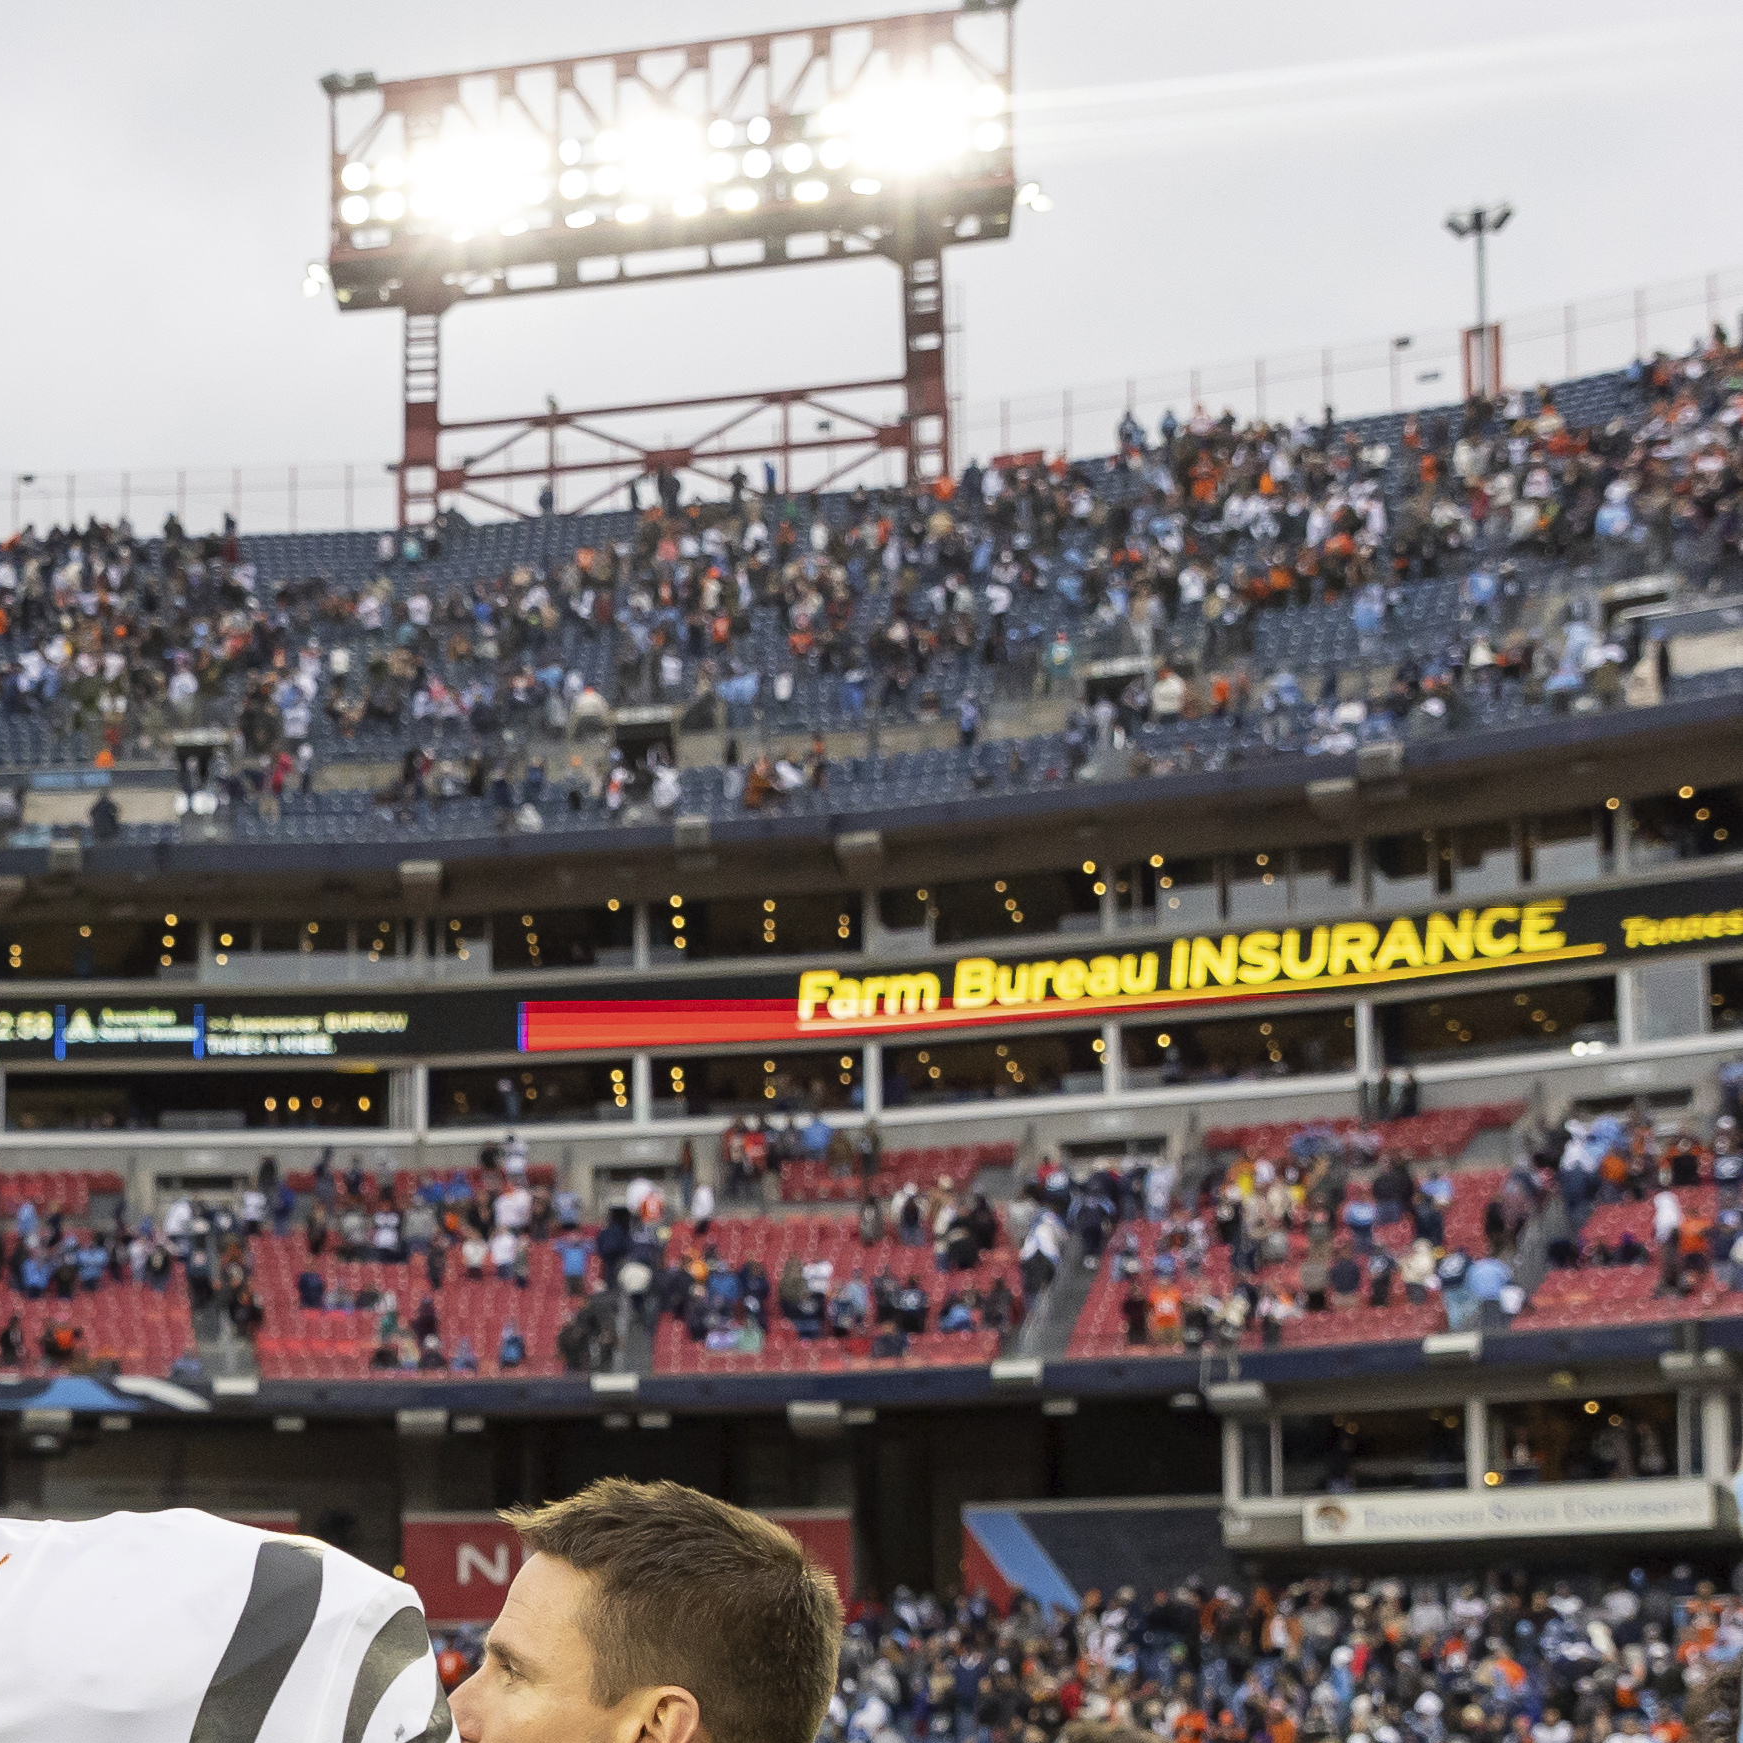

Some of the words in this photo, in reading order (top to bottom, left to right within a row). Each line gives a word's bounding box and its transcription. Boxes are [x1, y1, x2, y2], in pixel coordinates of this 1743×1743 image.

[798, 969, 942, 1022] Farm
[953, 943, 1160, 1011] Bureau
[1171, 898, 1567, 992] INSURANCE
